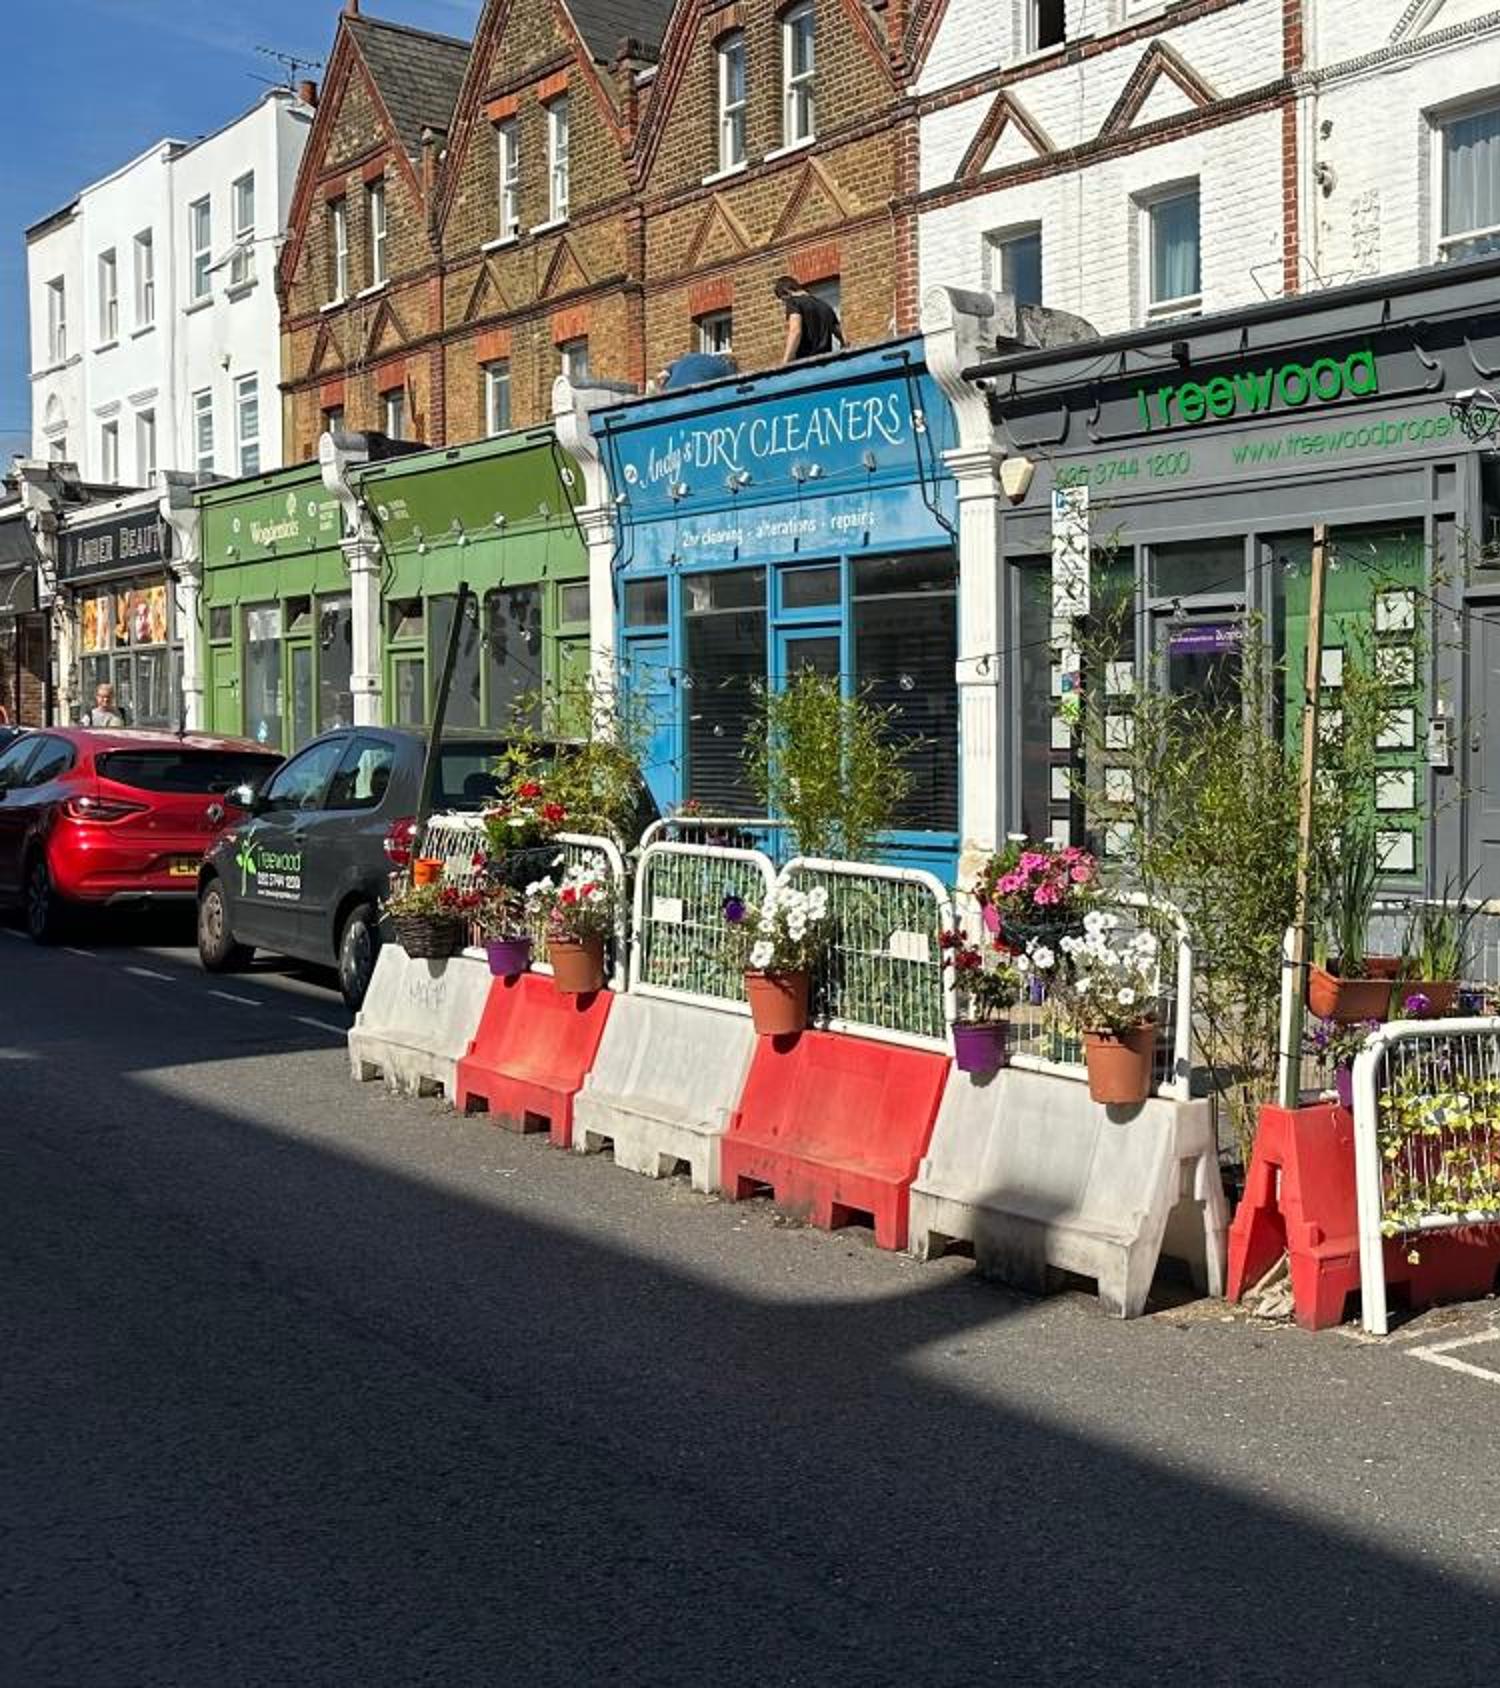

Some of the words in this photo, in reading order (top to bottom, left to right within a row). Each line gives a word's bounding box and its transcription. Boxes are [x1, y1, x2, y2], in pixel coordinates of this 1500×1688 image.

[640, 430, 691, 488] Andy's
[693, 421, 745, 472] DRY
[750, 393, 905, 457] CLEANERS
[1147, 450, 1191, 477] 1200
[701, 525, 744, 545] cleaning
[756, 515, 816, 539] alterations
[831, 509, 876, 533] repairs
